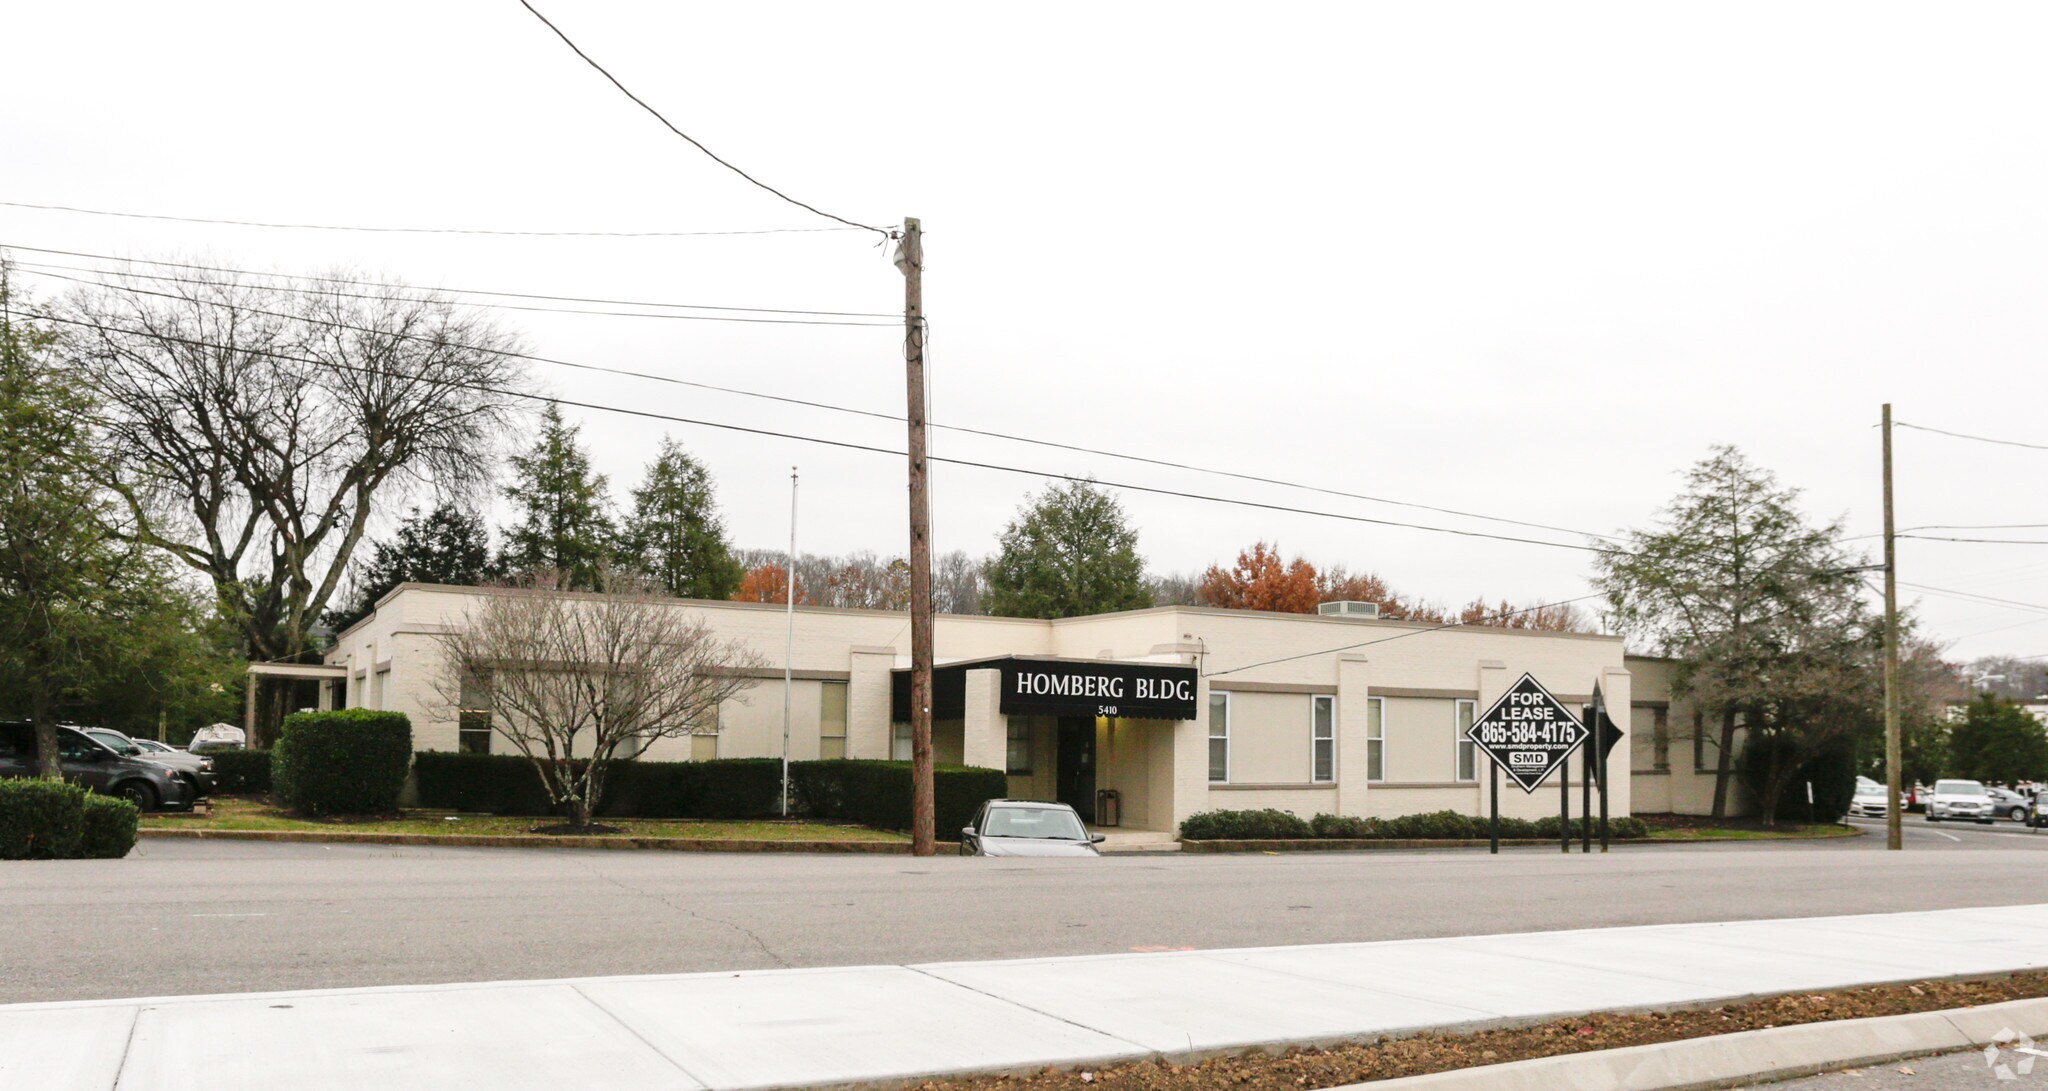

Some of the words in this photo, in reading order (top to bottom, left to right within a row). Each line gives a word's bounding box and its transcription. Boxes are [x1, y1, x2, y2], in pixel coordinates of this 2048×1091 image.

[1017, 672, 1124, 698] HOMBERG
[1135, 678, 1195, 701] BLDG.
[1510, 693, 1544, 705] FOR
[1098, 705, 1118, 715] 5410
[1501, 707, 1554, 720] LEASE
[1481, 722, 1575, 742] 865-584-4175
[1513, 753, 1544, 763] SMD
